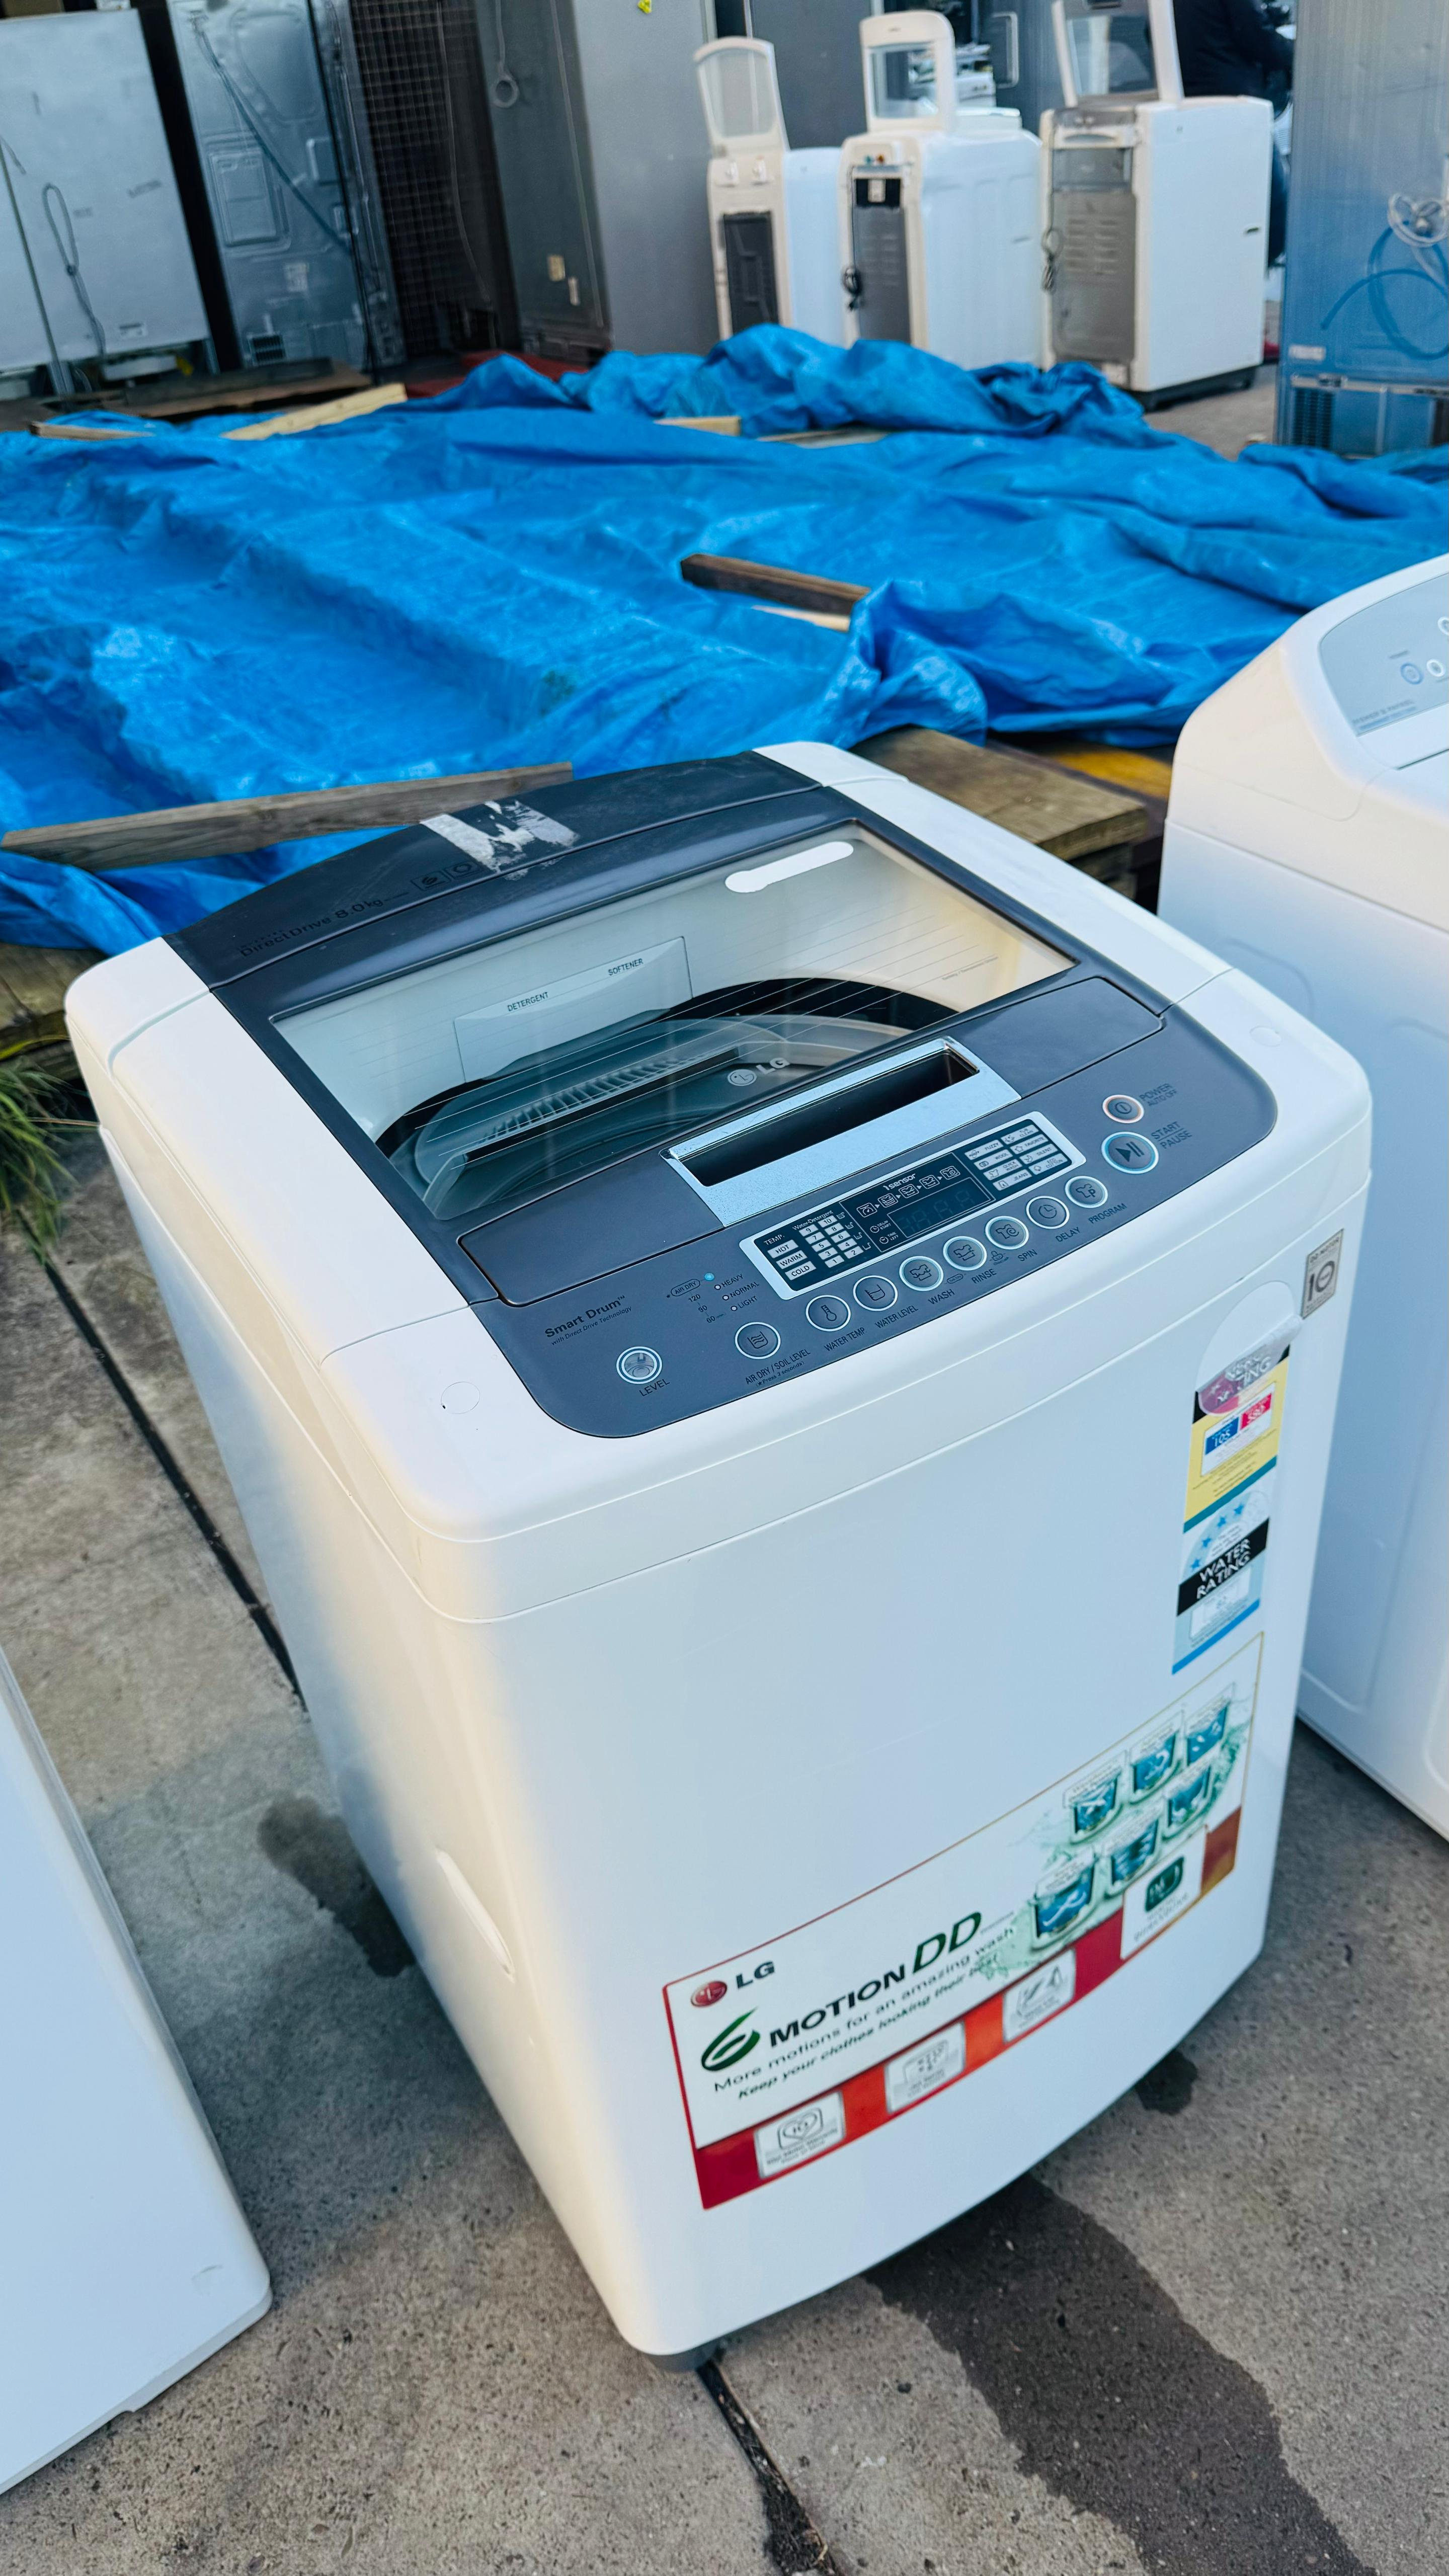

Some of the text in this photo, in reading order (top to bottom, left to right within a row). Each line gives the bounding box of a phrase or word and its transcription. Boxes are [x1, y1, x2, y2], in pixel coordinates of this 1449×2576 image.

[608, 958, 644, 976] SOFTENER
[507, 992, 549, 1012] DETERGENT
[756, 1057, 790, 1075] LG
[1139, 1083, 1173, 1101] POWER
[1151, 1121, 1181, 1140] START
[1160, 1131, 1192, 1149] PAUSE
[1088, 1203, 1128, 1224] PROGRAM
[1056, 1227, 1081, 1243] DELAY
[775, 1244, 789, 1254] HOT
[1017, 1249, 1038, 1262] SPIN
[780, 1253, 803, 1267] WARM
[721, 1273, 744, 1287] HEAVY
[791, 1265, 810, 1277] COLD
[971, 1268, 997, 1283] RINSE
[688, 1294, 701, 1302] 120
[730, 1281, 760, 1298] NORMAL
[927, 1289, 955, 1305] WASH
[738, 1296, 758, 1309] LIGHT
[874, 1305, 919, 1328] WATER LEVEL
[544, 1316, 585, 1337] Smart
[551, 1306, 632, 1346] with Direct Drive Technology
[824, 1336, 849, 1352] WATER
[746, 1374, 758, 1385] AIR
[756, 1367, 771, 1379] DRY
[774, 1358, 791, 1370] SOIL
[789, 1349, 811, 1362] LEVEL
[639, 1379, 670, 1397] LEVEL
[1199, 1538, 1251, 1582] WATER
[1196, 1550, 1252, 1599] RATING
[736, 1961, 775, 1989] LG
[714, 1927, 1014, 2092] More motions for an amazing wash
[738, 2076, 778, 2100] Keep
[782, 2057, 817, 2082] your
[821, 2028, 874, 2060] clothes
[879, 1995, 931, 2029] looking
[934, 1973, 965, 1997] their
